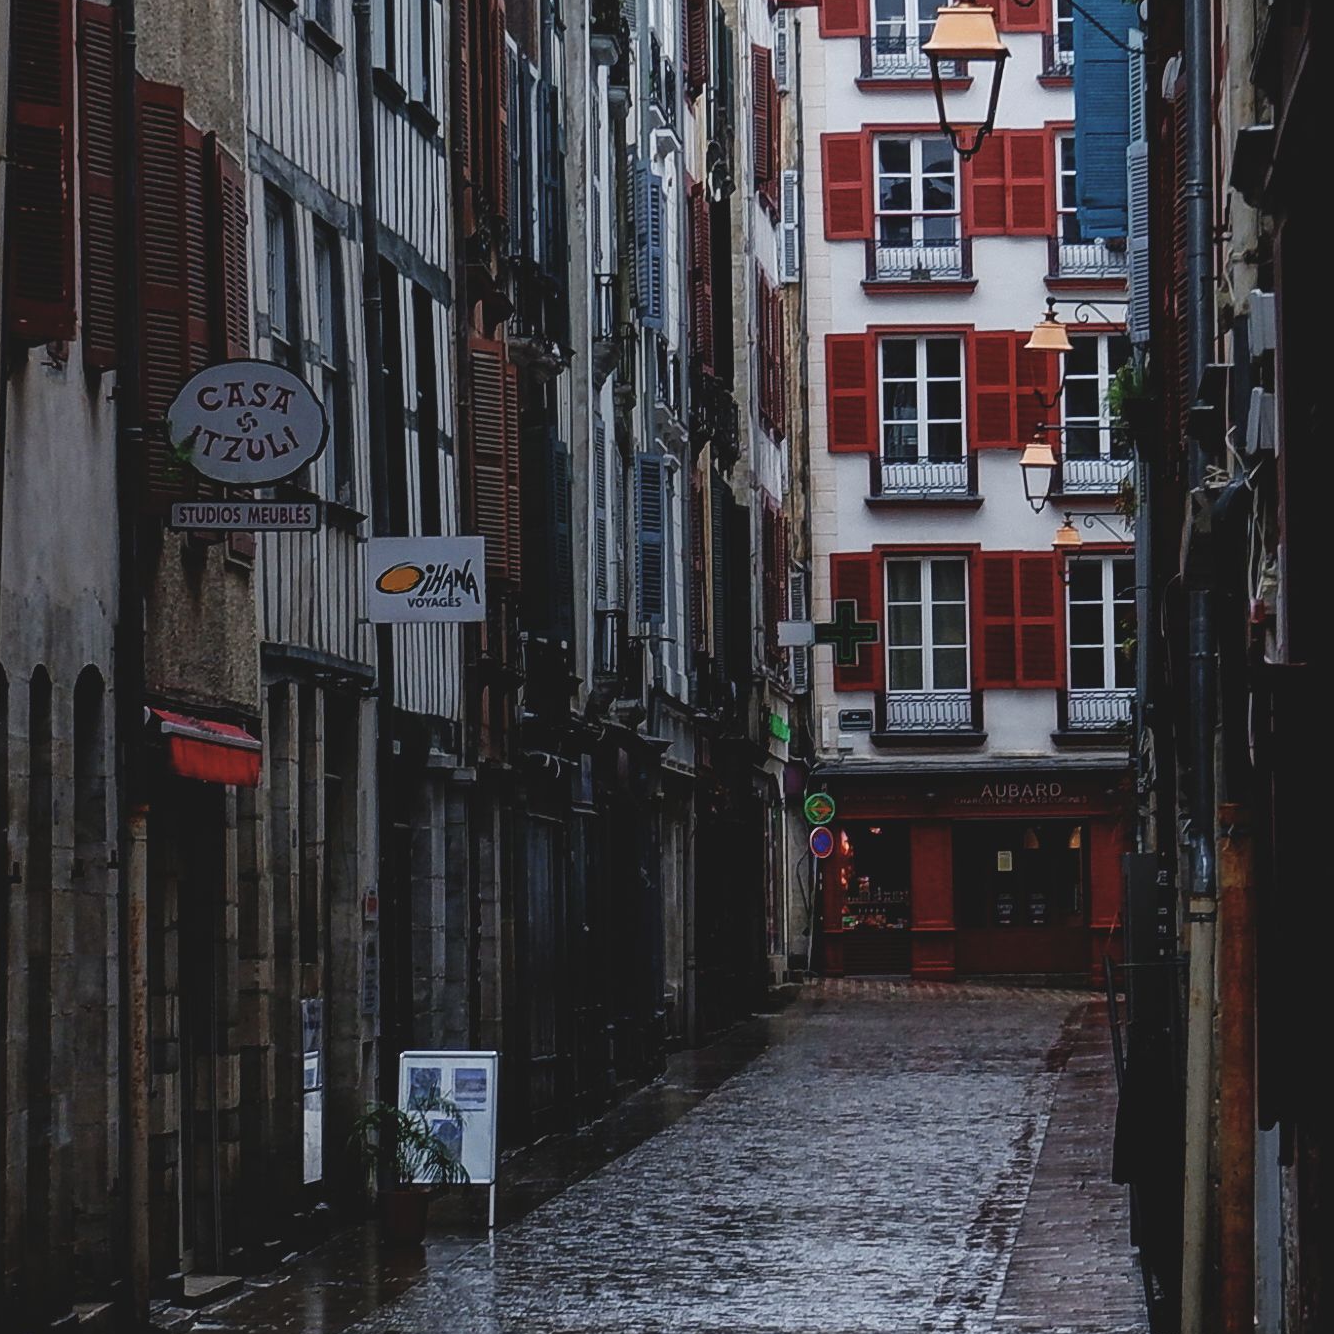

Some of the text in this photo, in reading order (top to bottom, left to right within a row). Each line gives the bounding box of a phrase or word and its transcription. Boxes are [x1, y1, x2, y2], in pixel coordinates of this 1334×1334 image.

[197, 382, 295, 415] CASA
[179, 503, 311, 524] STUDIOS MEUBLÉS
[407, 596, 462, 608] VOYAGES
[980, 783, 1062, 797] AUBARD
